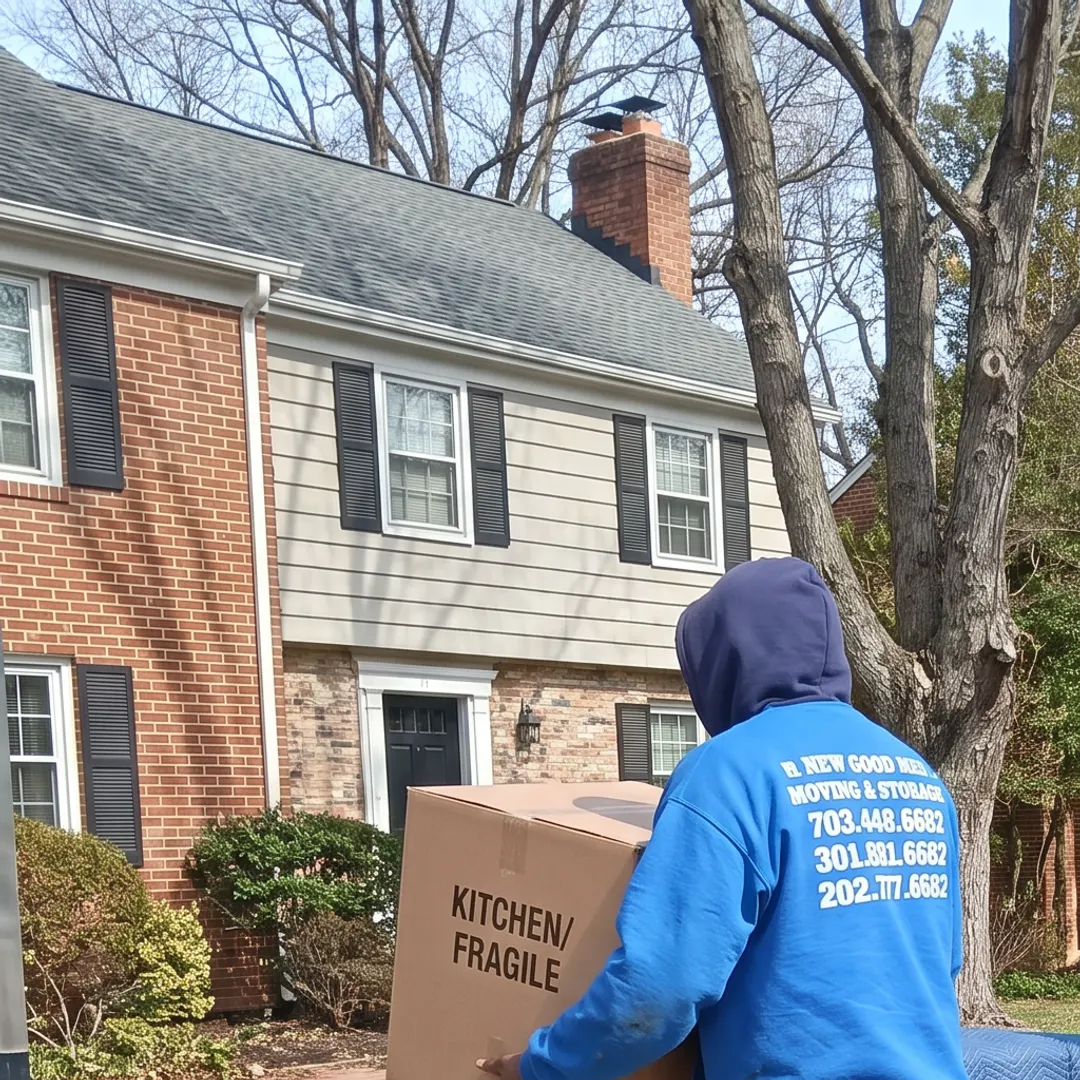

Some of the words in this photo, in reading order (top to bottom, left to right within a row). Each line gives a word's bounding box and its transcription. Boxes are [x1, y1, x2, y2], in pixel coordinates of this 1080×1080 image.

[800, 754, 845, 775] NEW
[848, 754, 896, 774] GOOD
[787, 780, 861, 805] MOVING
[863, 779, 876, 800] &
[877, 780, 945, 803] STORAGE
[808, 808, 944, 838] 703.448.6682
[814, 841, 947, 873] 301.881.6682
[452, 884, 575, 951] KITCHEN/
[453, 931, 561, 993] FRAGILE
